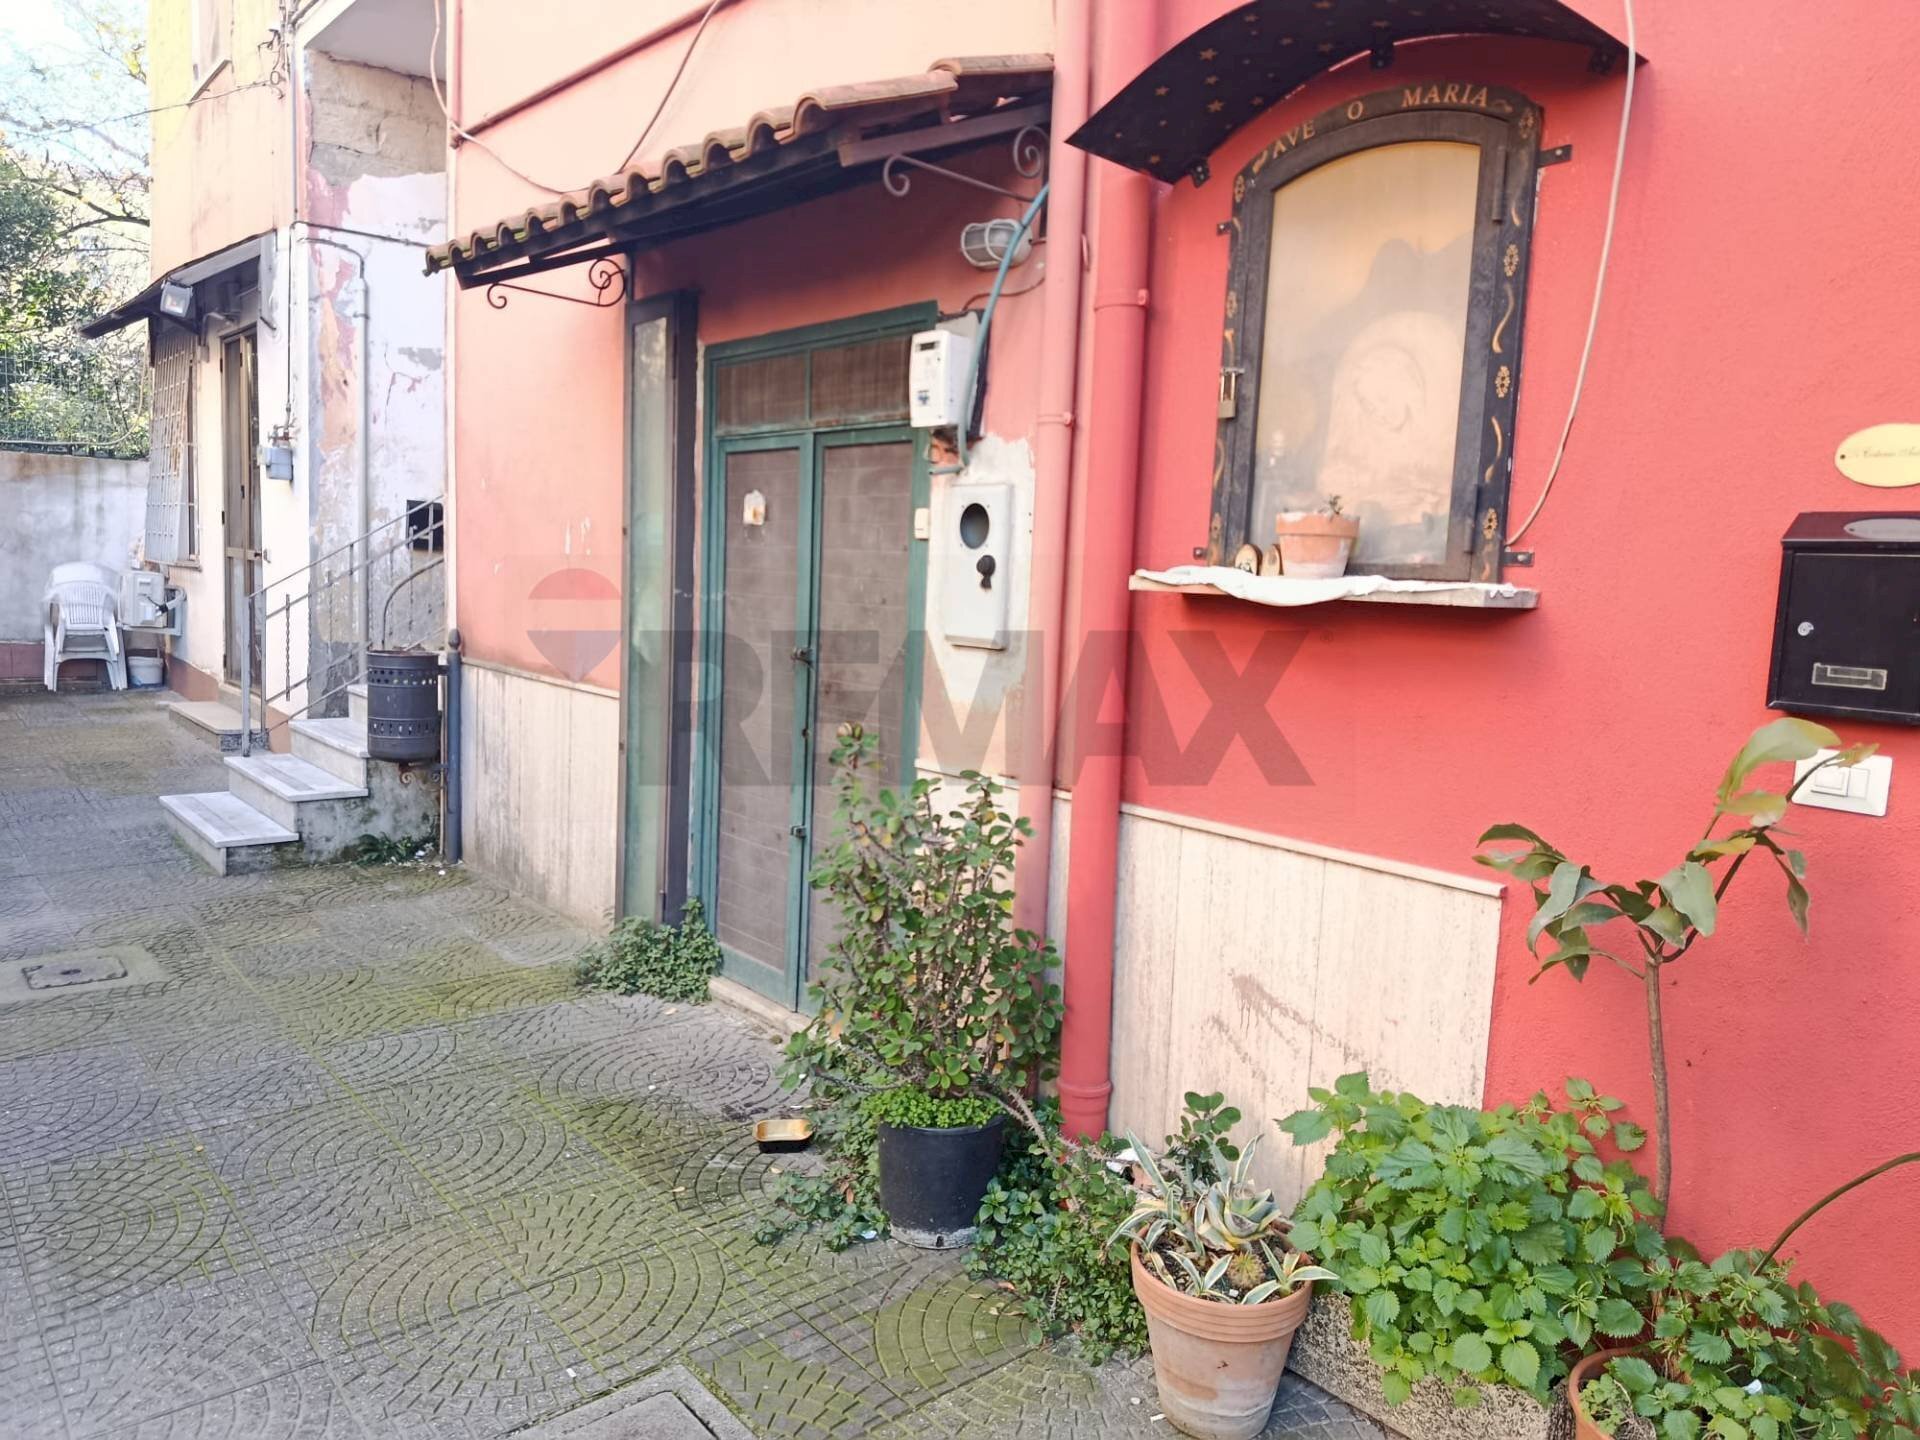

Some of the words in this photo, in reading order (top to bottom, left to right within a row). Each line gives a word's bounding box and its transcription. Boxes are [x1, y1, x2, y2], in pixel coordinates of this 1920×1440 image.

[1272, 120, 1316, 159] AVE
[1347, 100, 1364, 120] O
[1400, 83, 1489, 108] MARIA
